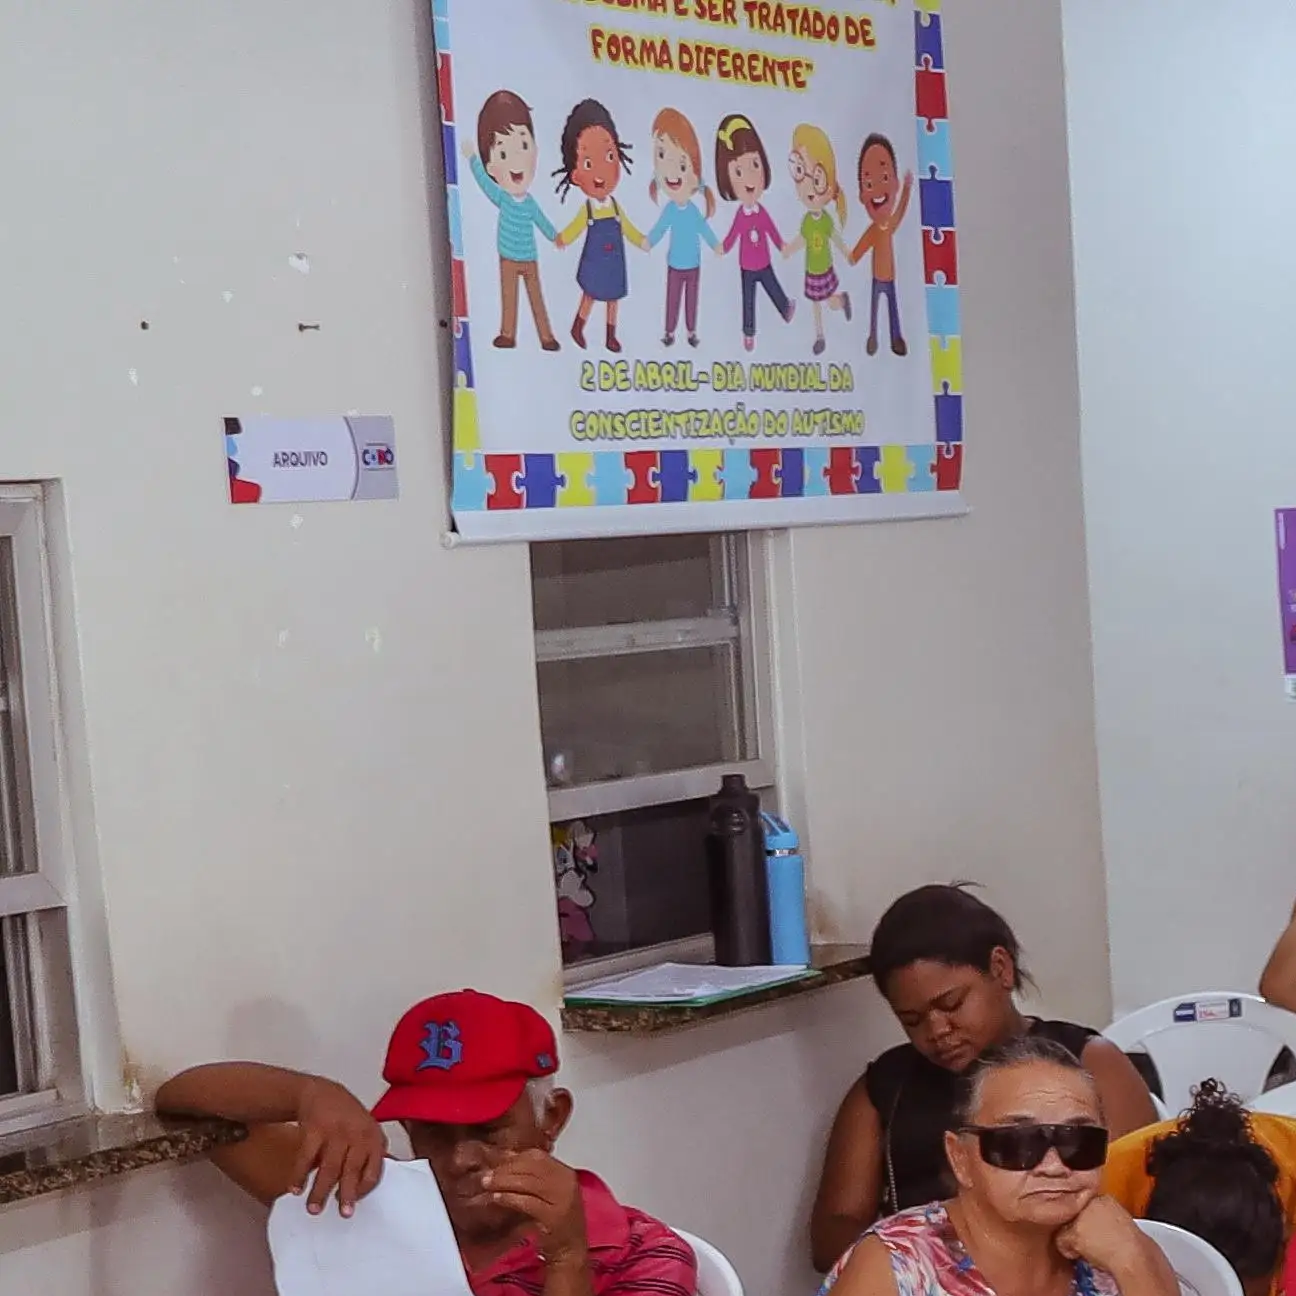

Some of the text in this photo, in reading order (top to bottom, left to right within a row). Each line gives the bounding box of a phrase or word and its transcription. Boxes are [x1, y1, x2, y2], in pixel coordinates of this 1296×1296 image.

[743, 1, 840, 42] TRATADO
[844, 15, 876, 47] DE
[590, 28, 674, 71] FORMA
[580, 360, 596, 391] 2
[599, 360, 630, 391] DE
[711, 361, 746, 392] DIA
[749, 361, 828, 392] MUNDIAL
[828, 362, 854, 392] DA
[569, 402, 866, 446] CONSCIENTIZAÇÃO DO AUTISMO
[272, 450, 329, 468] ARQUIVO
[416, 1020, 463, 1072] B
